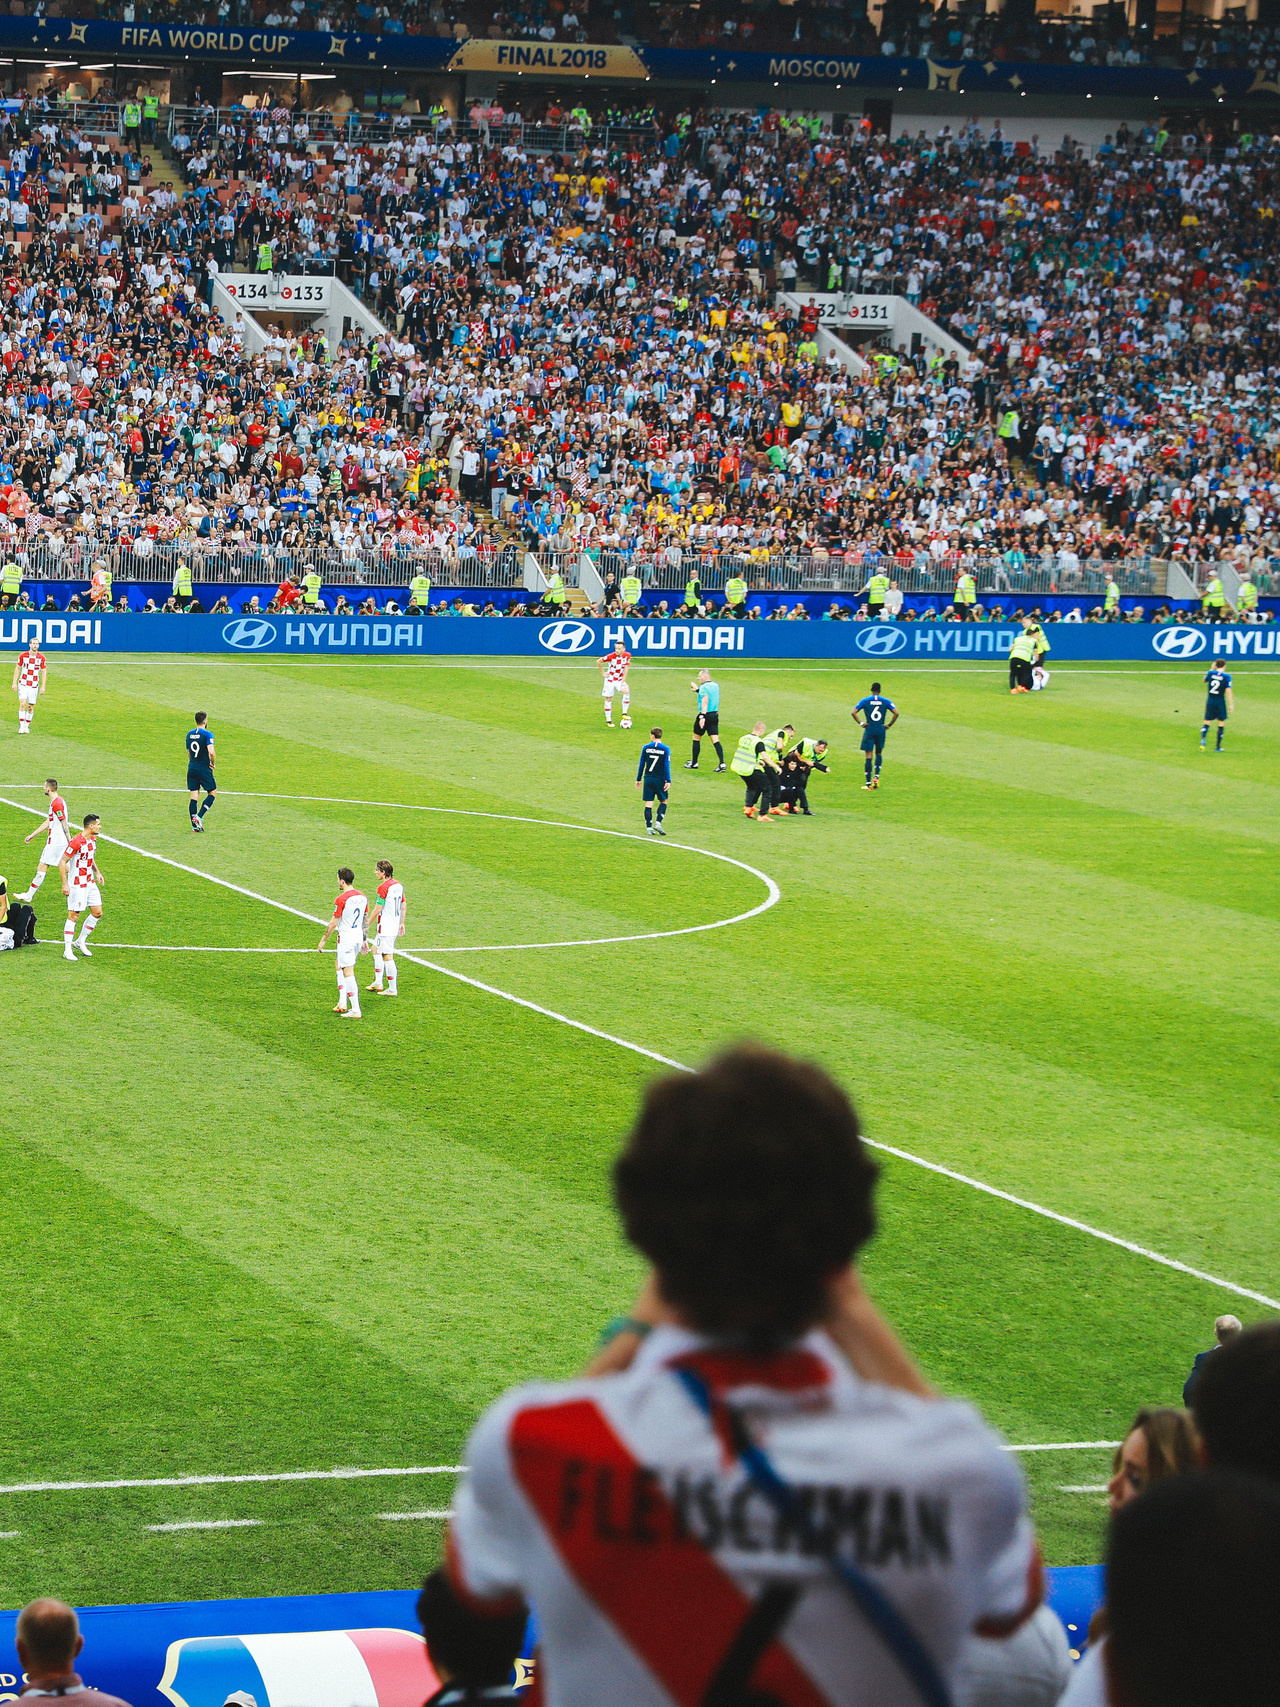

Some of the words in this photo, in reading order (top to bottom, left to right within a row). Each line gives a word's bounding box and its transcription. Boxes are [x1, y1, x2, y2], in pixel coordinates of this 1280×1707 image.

[121, 27, 162, 47] FIFA
[168, 30, 244, 51] WORLD
[497, 45, 557, 67] FINAL
[560, 48, 607, 69] 2018
[768, 58, 860, 79] MOSCOW
[238, 284, 267, 299] 134
[294, 286, 324, 301] 133
[819, 303, 835, 317] 32
[861, 305, 888, 319] 131
[285, 622, 423, 647] HYUNDAI
[603, 625, 745, 650] HYUNDAI
[914, 629, 1023, 652] HYUND
[1208, 680, 1221, 695] 2
[870, 705, 882, 722] 6
[190, 741, 200, 758] 9
[648, 755, 660, 772] 7
[393, 896, 402, 917] 10
[351, 907, 361, 929] 2
